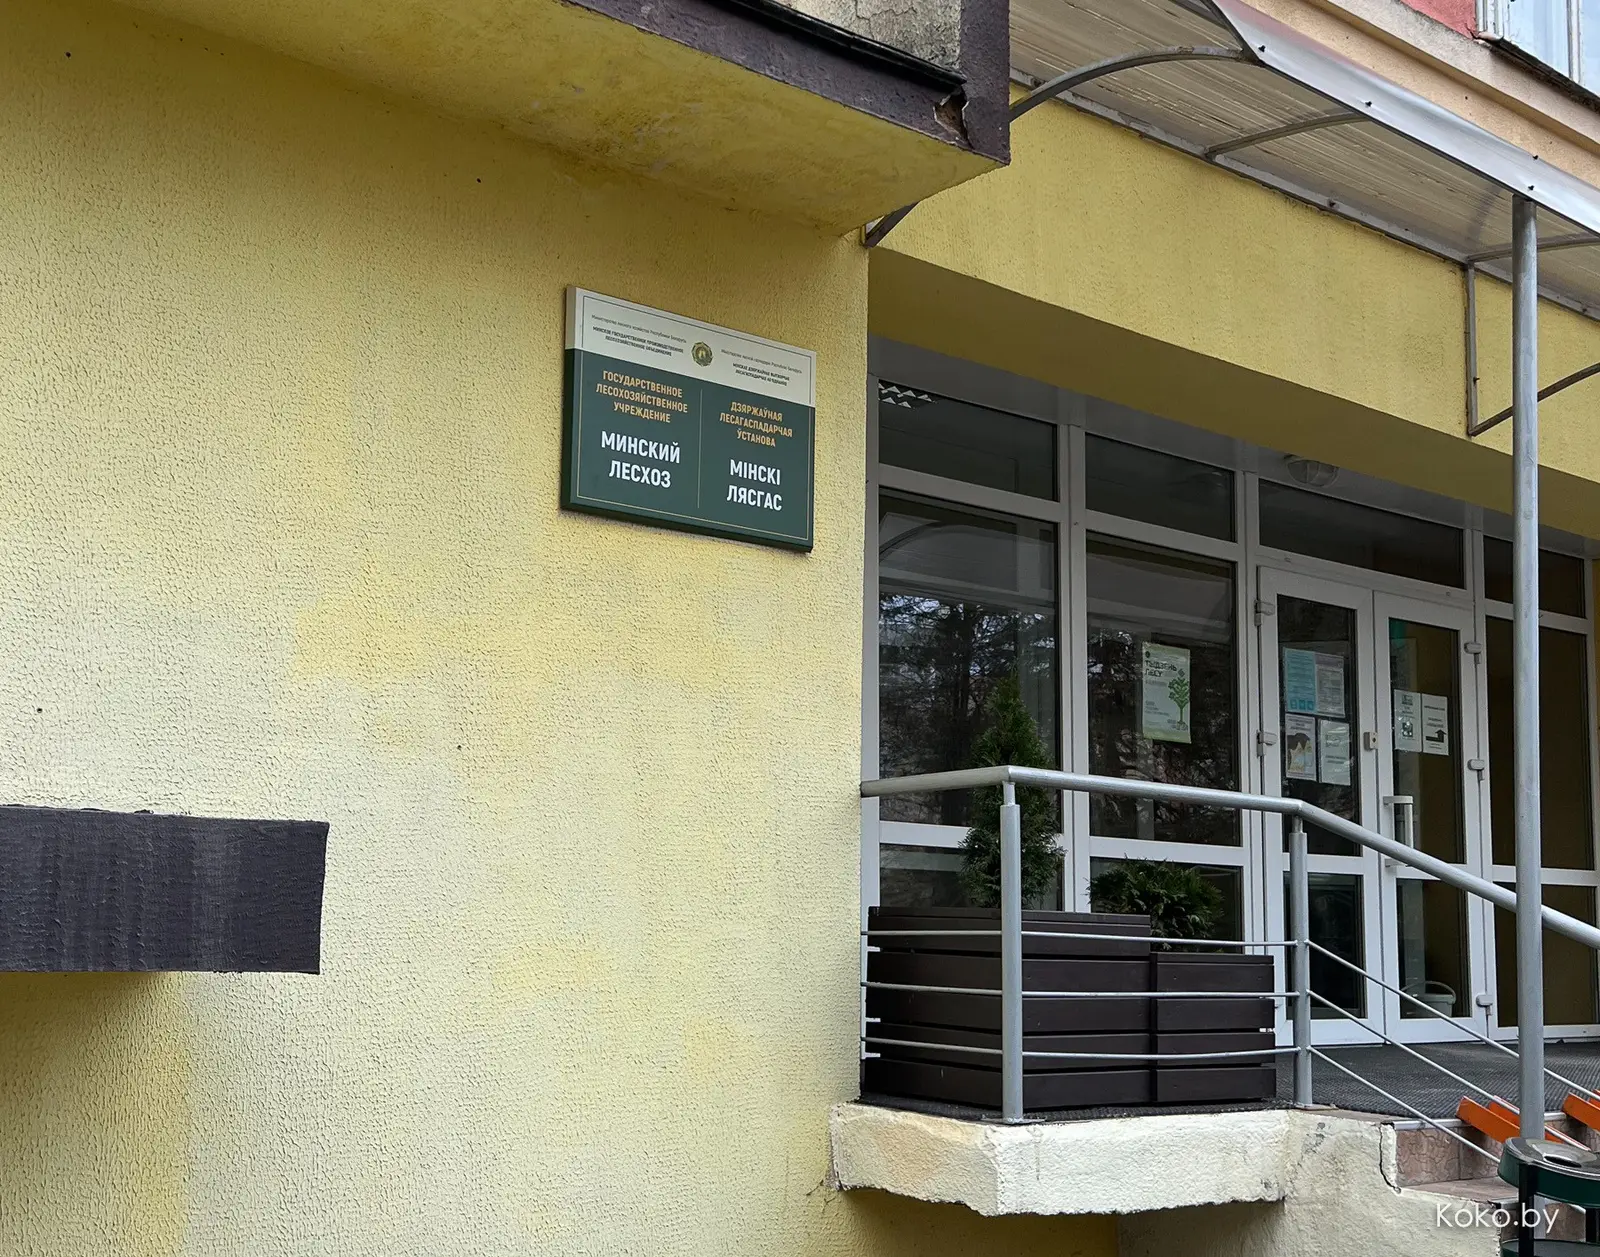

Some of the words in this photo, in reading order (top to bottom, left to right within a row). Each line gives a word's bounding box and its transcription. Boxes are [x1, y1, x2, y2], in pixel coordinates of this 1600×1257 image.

[602, 370, 683, 398] ГОСУДАРСТВЕННОЕ
[596, 383, 688, 413] ЛЕСОХОЗЯЙСТВЕННОЕ
[730, 401, 783, 422] ДЗЯРЖАЎНАЯ
[613, 401, 671, 423] УЧРЕЖДЕНИЕ
[719, 412, 793, 438] ЛЕСАГАСПАДАРЧАЯ
[601, 430, 681, 464] МИНСКИЙ
[736, 428, 776, 447] ЎСТАНОВА
[608, 459, 672, 488] ЛЕСХОЗ
[729, 458, 781, 486] МІНСКІ
[726, 484, 783, 511] ЛЯСГАС
